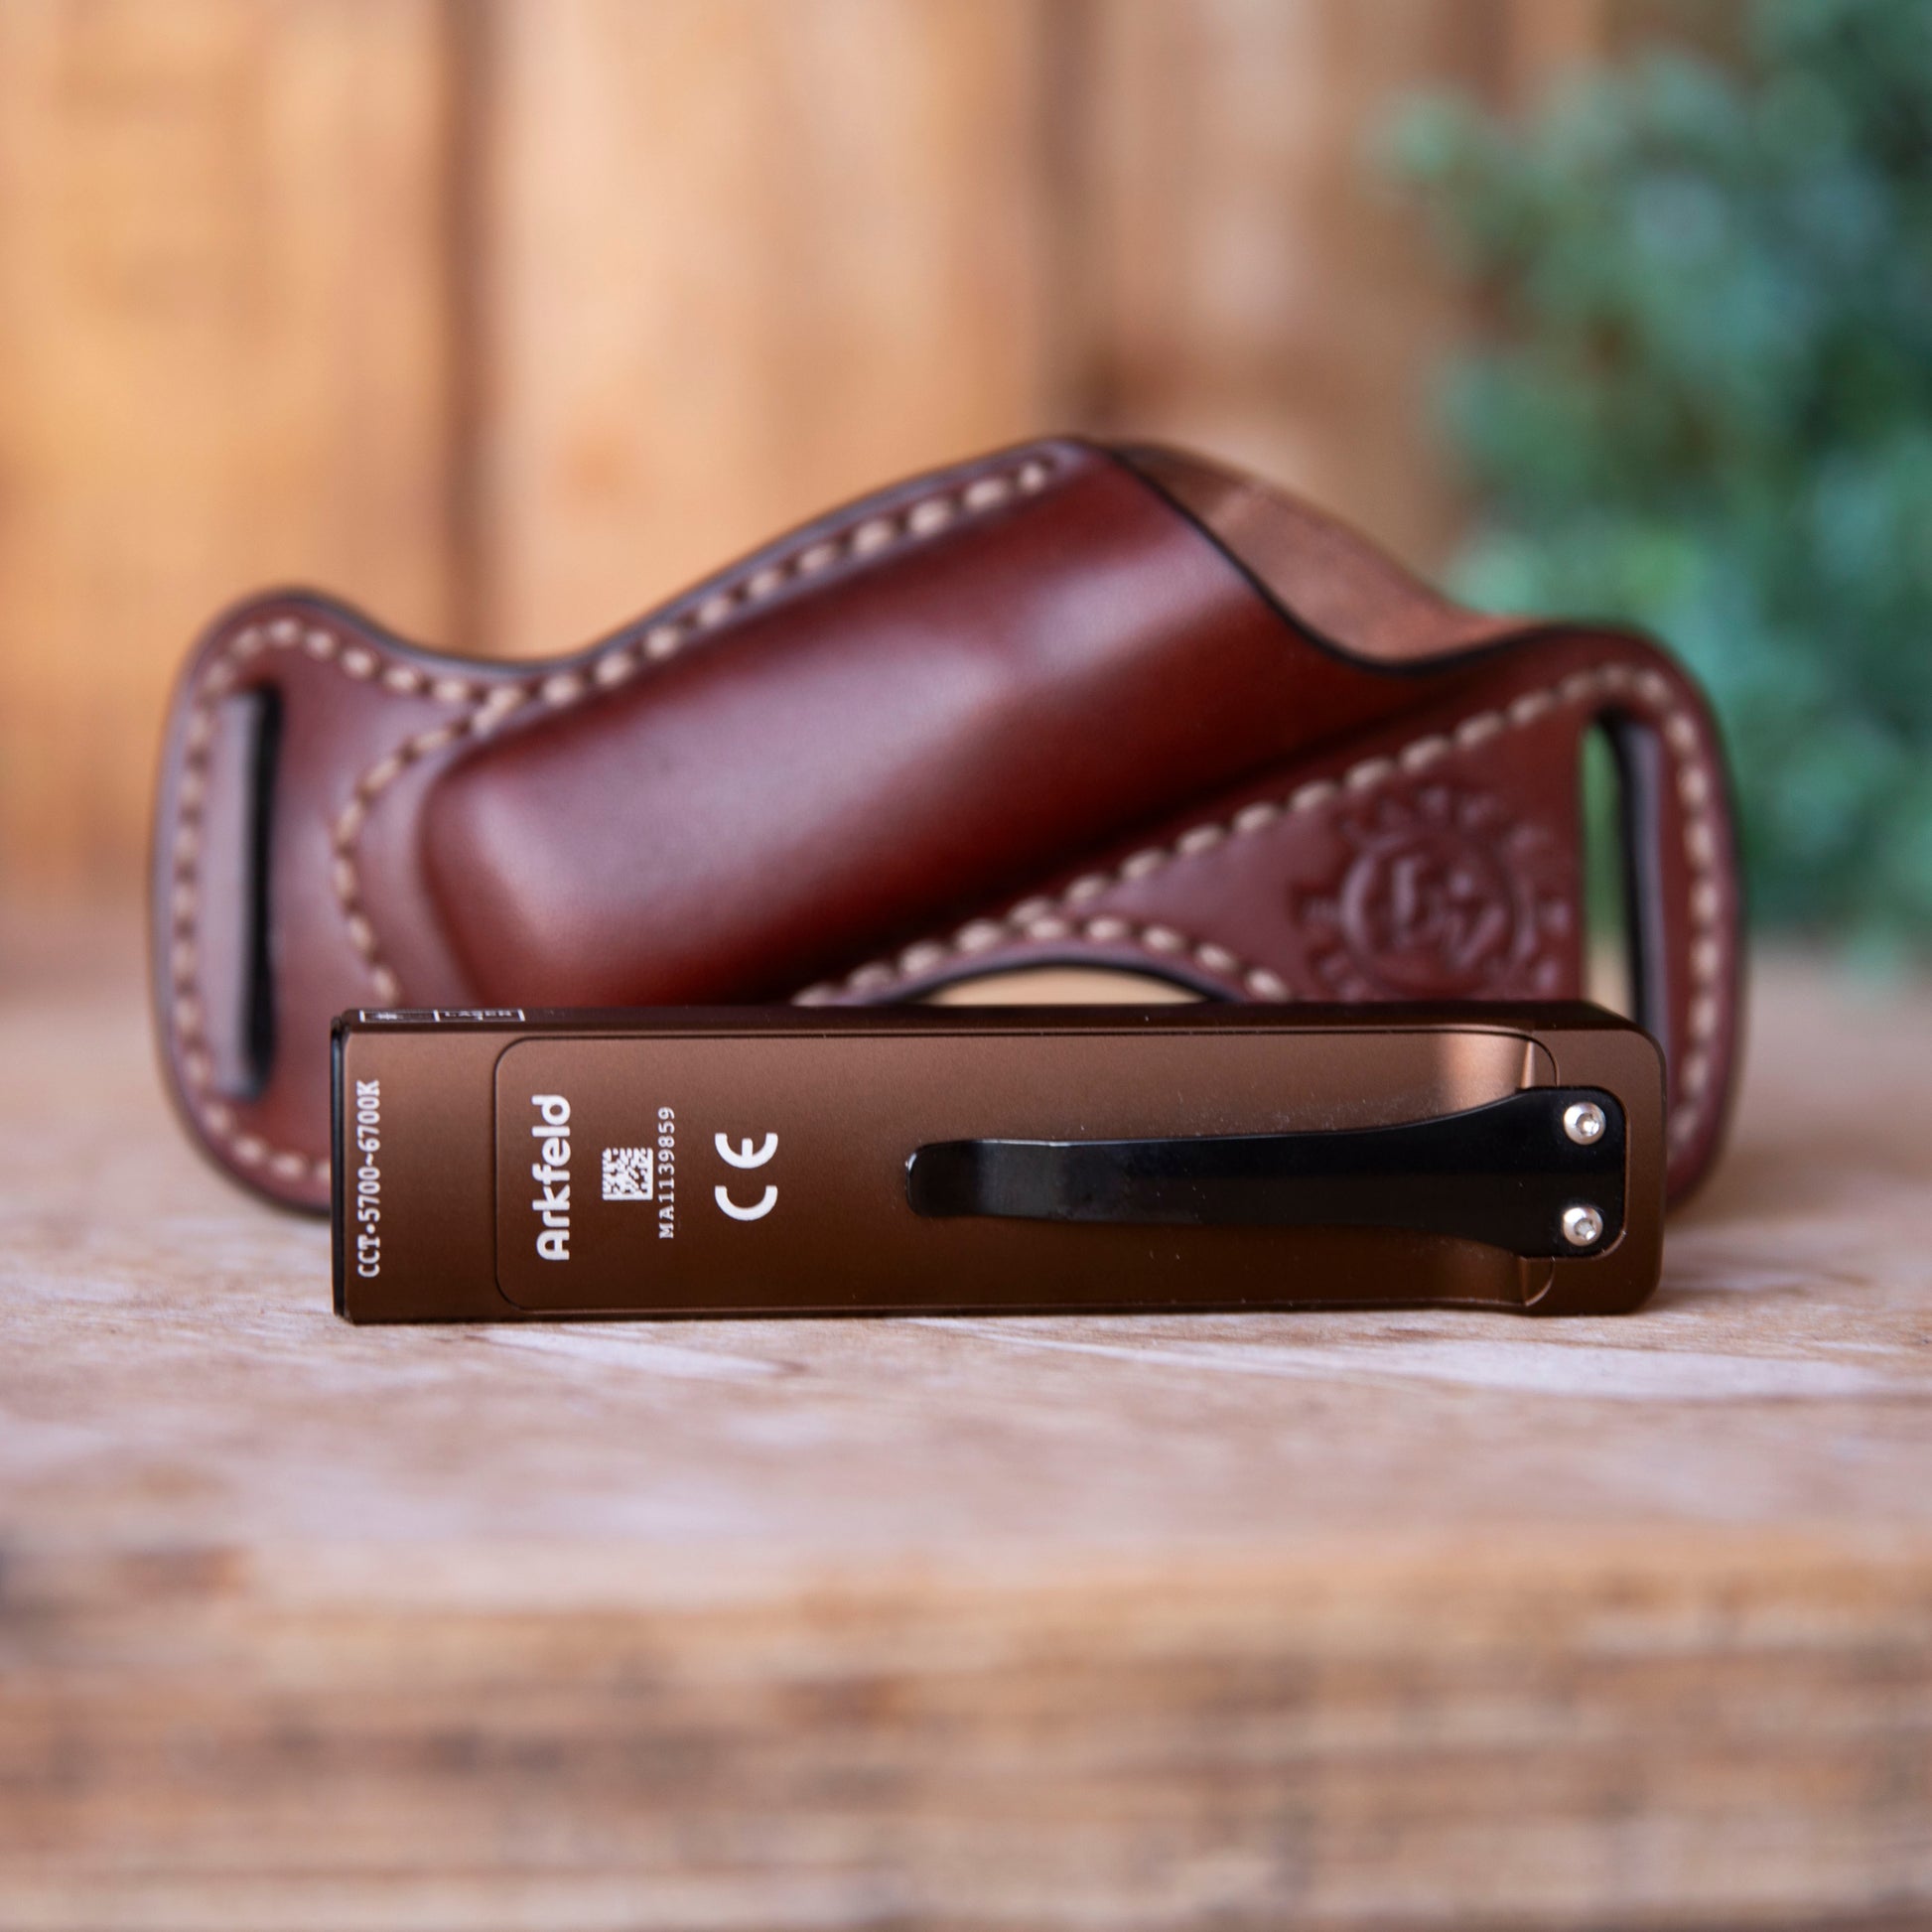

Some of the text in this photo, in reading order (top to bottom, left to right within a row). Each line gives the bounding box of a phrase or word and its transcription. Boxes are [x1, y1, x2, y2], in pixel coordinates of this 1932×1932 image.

[531, 1094, 571, 1261] Arkfeld
[658, 1107, 675, 1239] MA1139859
[714, 1133, 779, 1221] CE
